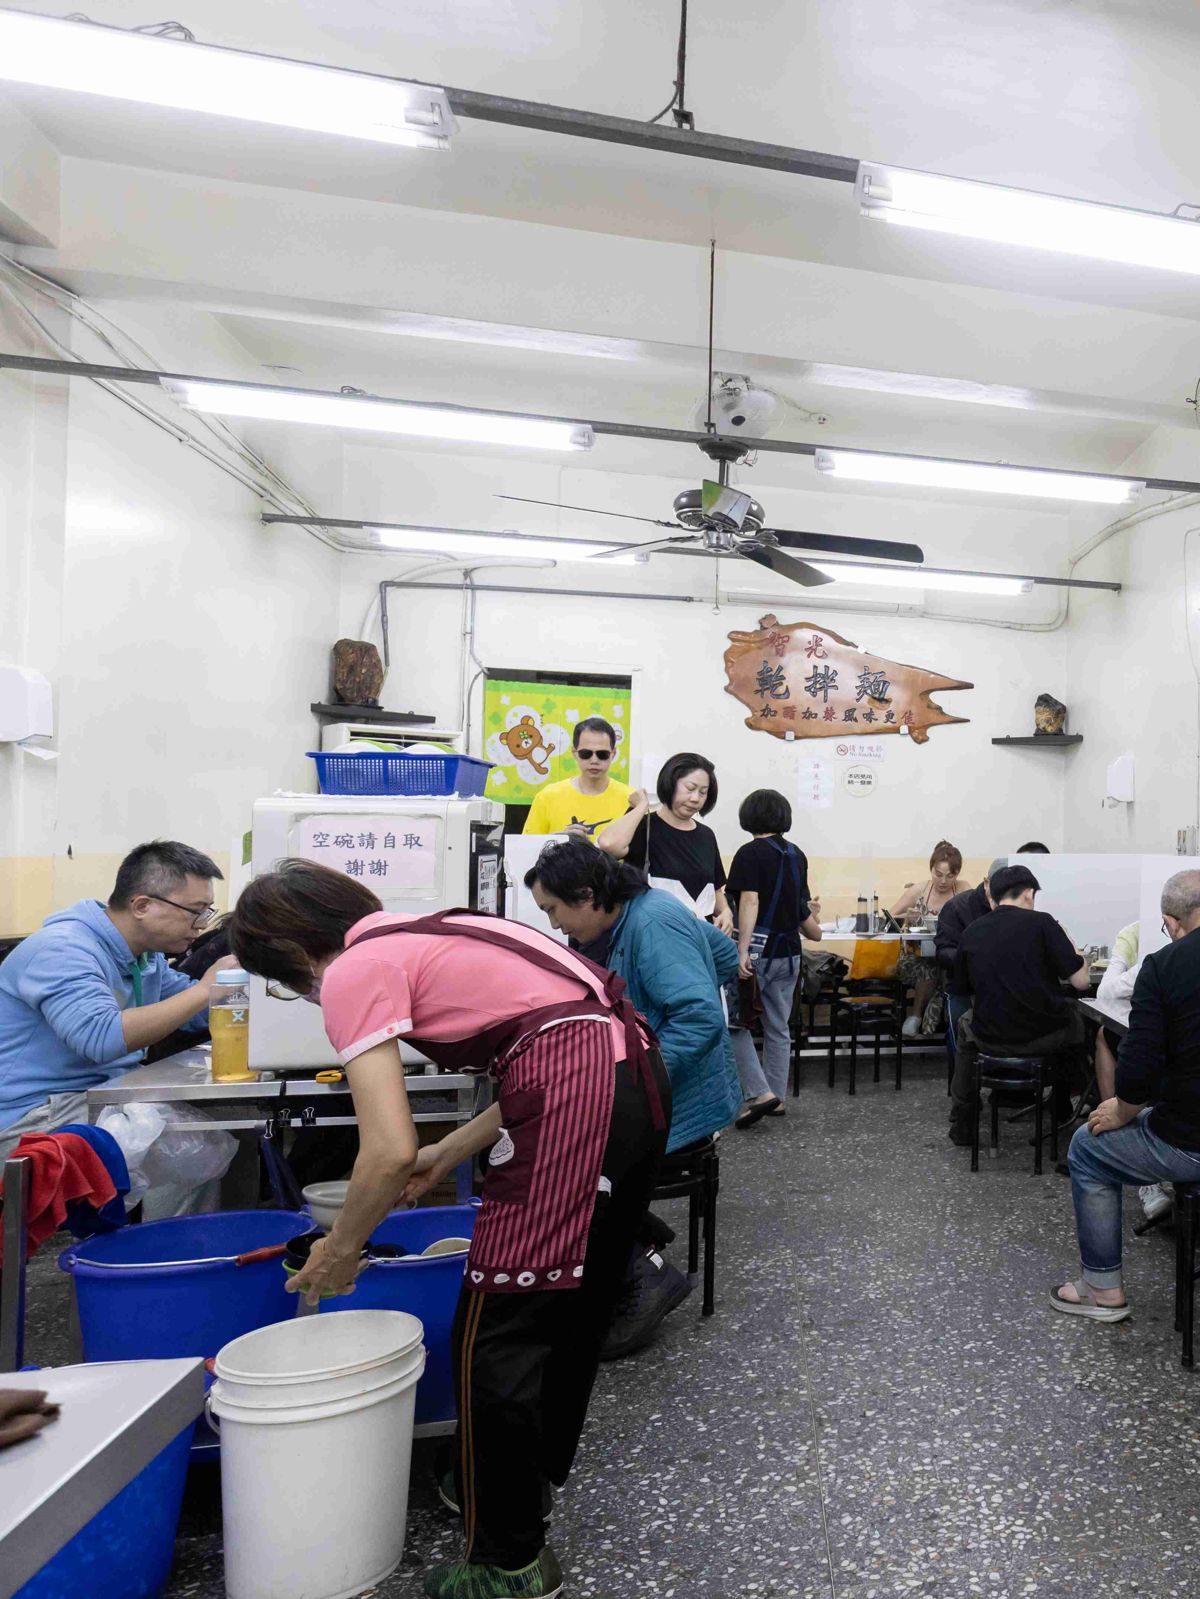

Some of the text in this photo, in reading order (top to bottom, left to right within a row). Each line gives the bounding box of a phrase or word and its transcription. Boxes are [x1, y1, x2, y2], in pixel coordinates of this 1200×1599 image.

[767, 631, 828, 659] 智光
[753, 661, 891, 703] 乾拌麵
[760, 703, 915, 725] 加醋加辣風味更佳
[312, 831, 424, 850] 空碗請自取
[345, 858, 389, 877] 謝謝
